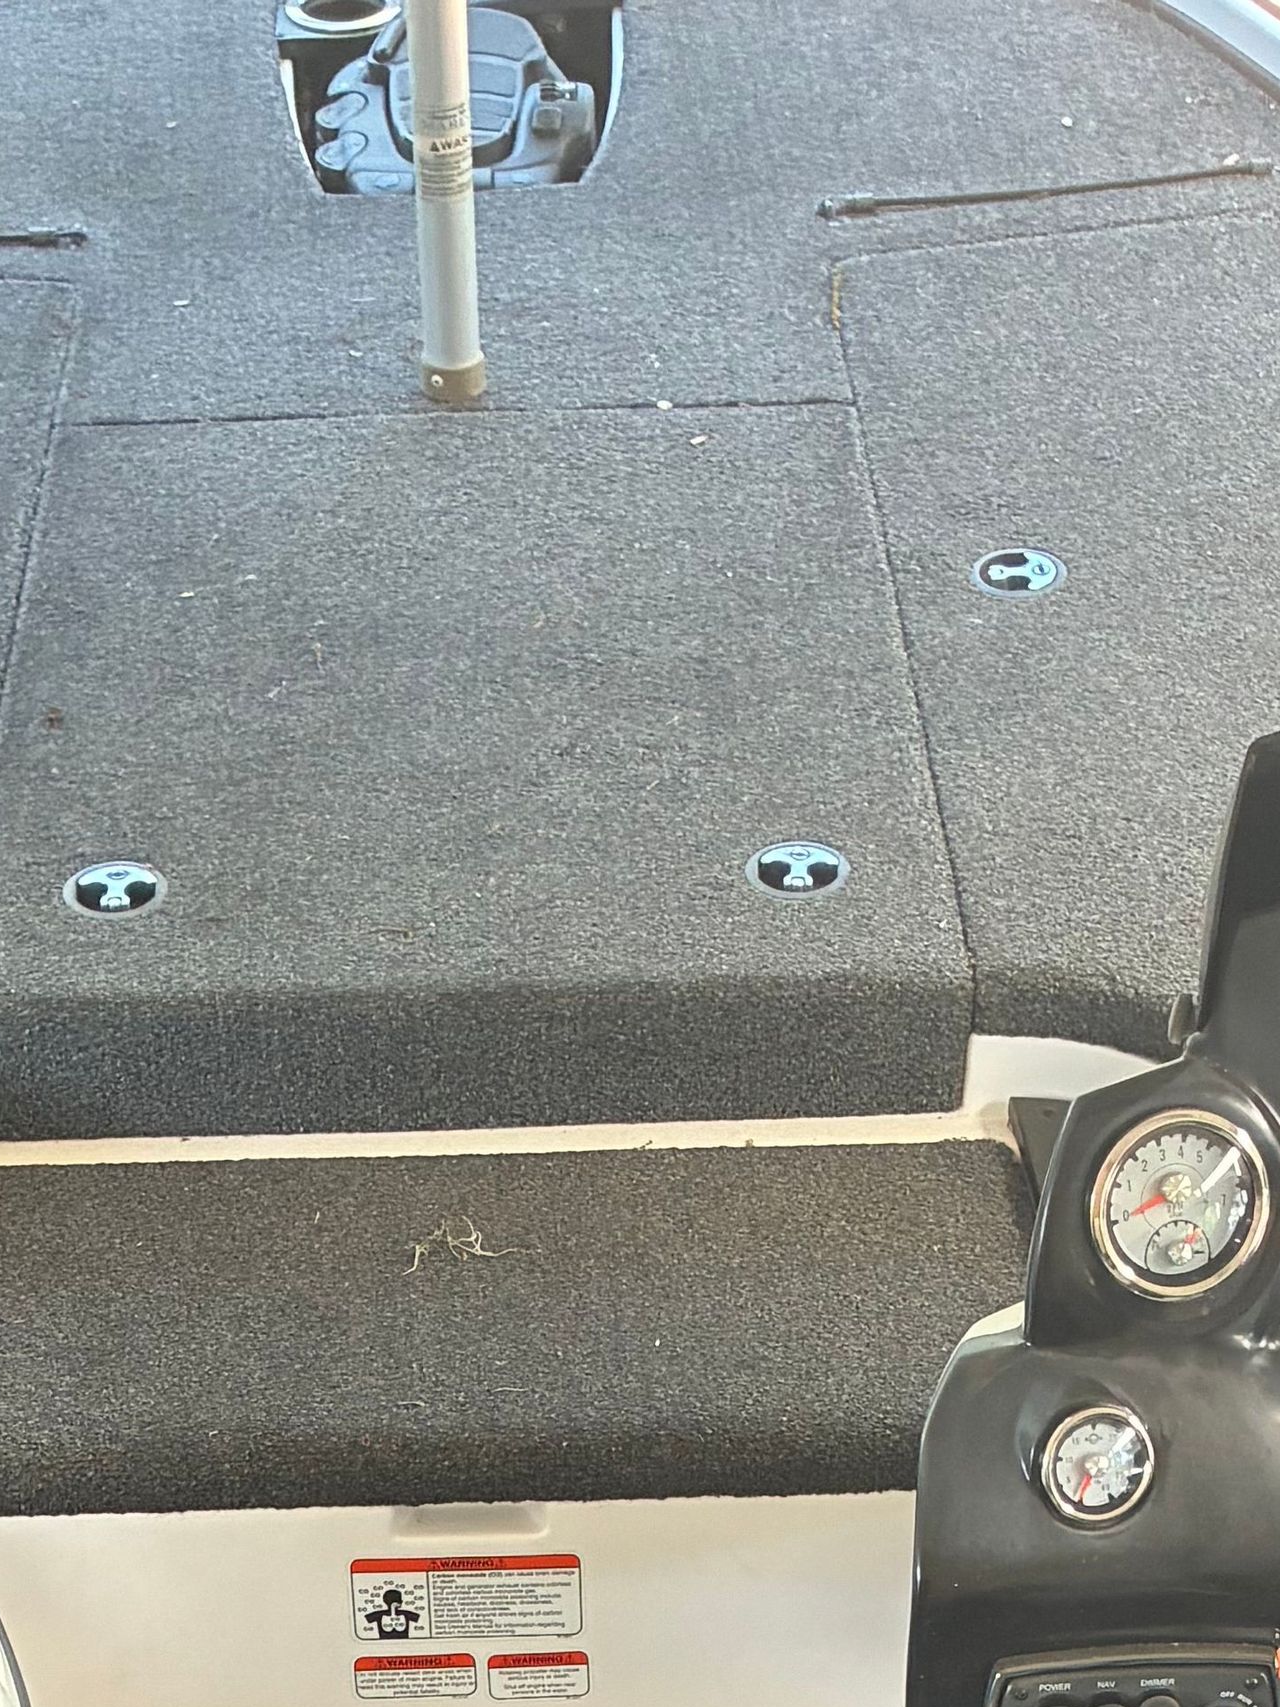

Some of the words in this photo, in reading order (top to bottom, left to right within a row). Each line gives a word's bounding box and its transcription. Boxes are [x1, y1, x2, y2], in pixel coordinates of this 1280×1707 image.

[1160, 1149, 1166, 1161] 3
[1178, 1146, 1184, 1158] 4
[1197, 1151, 1203, 1162] 5
[1142, 1160, 1148, 1172] 2
[1128, 1180, 1131, 1192] 1
[1123, 1210, 1130, 1221] 0
[511, 1655, 563, 1664] WARNING
[1039, 1683, 1071, 1692] POWER
[1140, 1678, 1175, 1687] DIMMER
